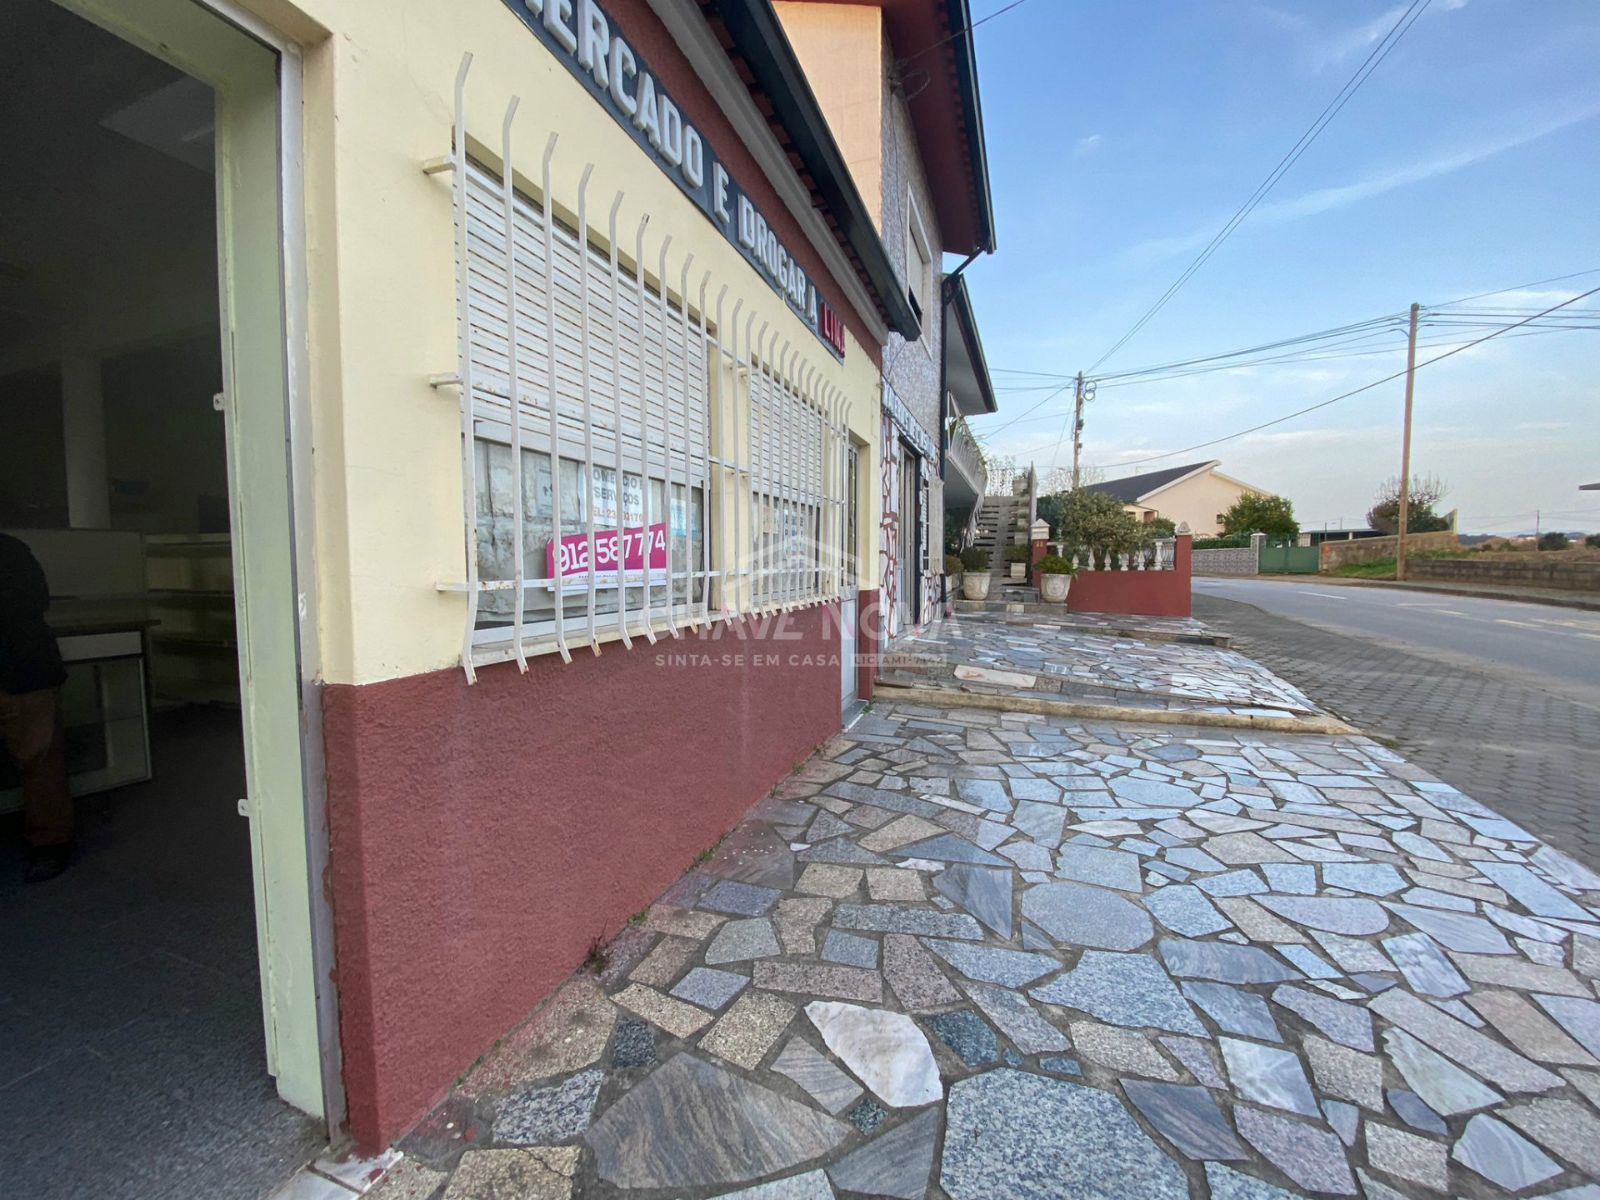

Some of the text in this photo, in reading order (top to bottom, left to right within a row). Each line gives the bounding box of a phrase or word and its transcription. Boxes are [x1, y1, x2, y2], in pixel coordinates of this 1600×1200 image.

[525, 0, 704, 190] ERCADO
[713, 161, 731, 225] E
[738, 193, 817, 324] DROGARA
[593, 486, 640, 506] SERÇOS
[553, 541, 591, 573] 912
